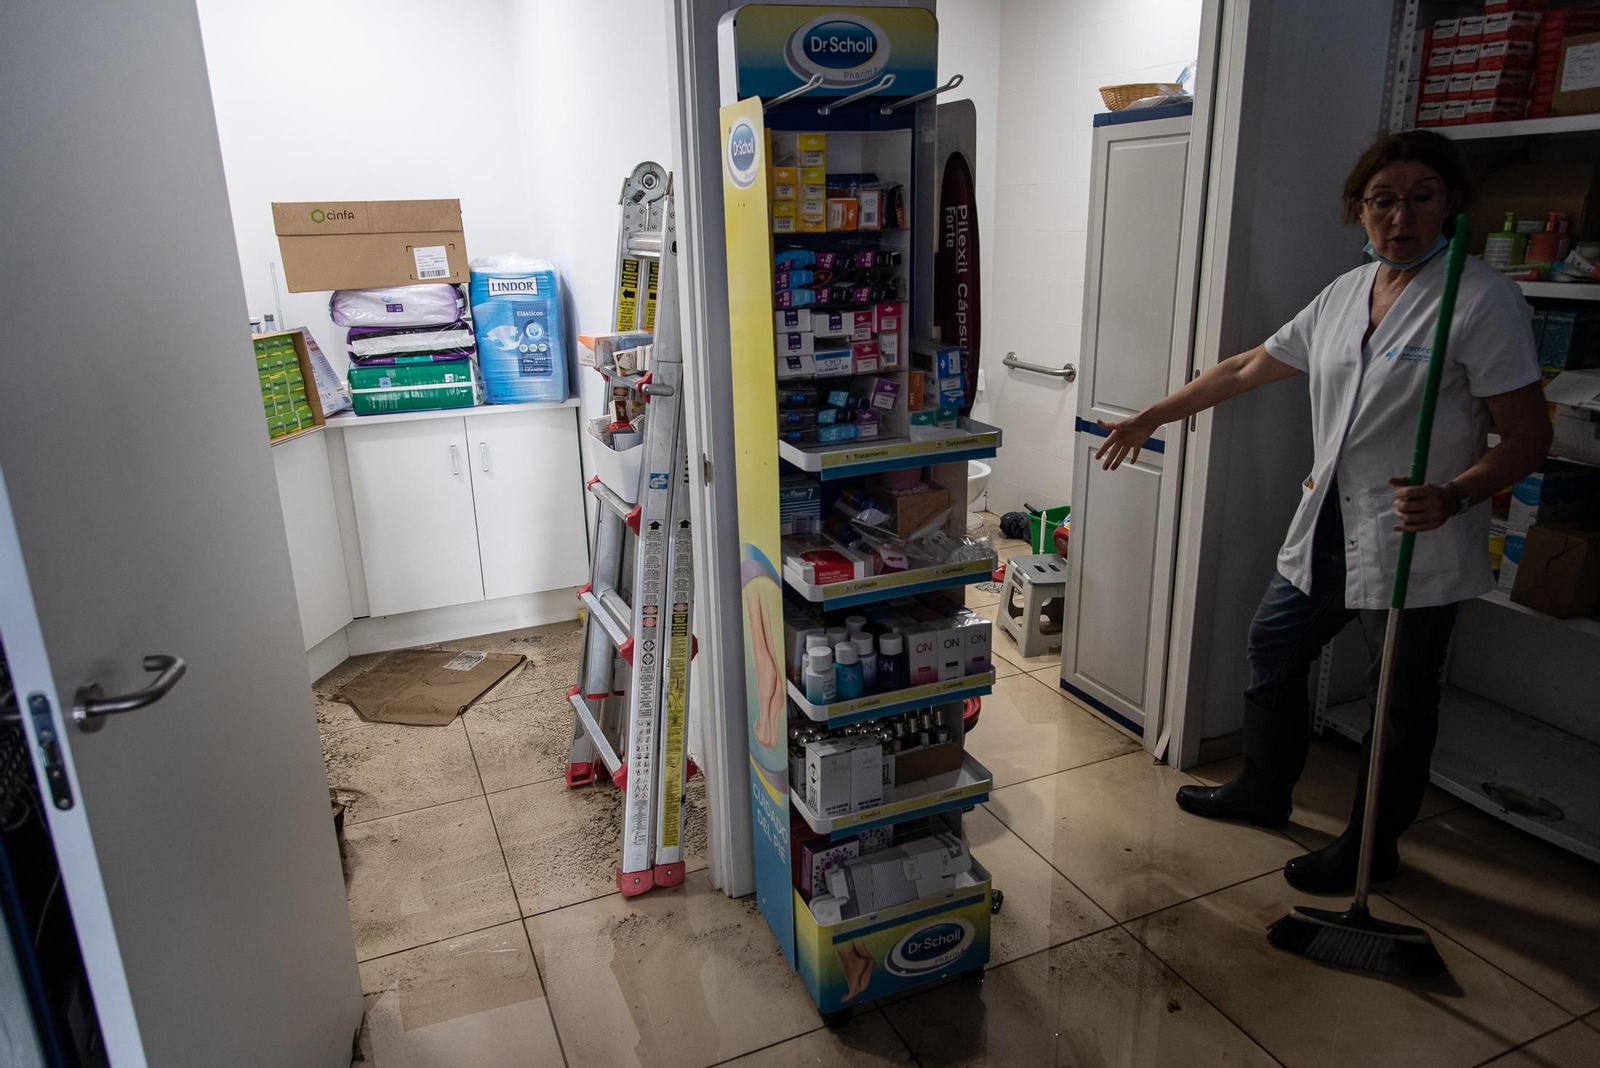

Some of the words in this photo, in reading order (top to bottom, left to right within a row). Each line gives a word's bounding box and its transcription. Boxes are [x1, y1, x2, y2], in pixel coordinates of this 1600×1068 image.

[326, 209, 356, 222] cinfa
[946, 206, 956, 248] Forte
[957, 204, 968, 273] Pilexil
[491, 281, 535, 293] LINDOR
[516, 310, 544, 318] Elásticos
[853, 449, 889, 460] Tratamiento
[854, 580, 878, 590] Cuidado
[944, 637, 960, 649] ON
[970, 633, 987, 645] ON
[916, 642, 932, 654] ON
[878, 660, 893, 672] ON
[752, 783, 788, 844] CUIDADO
[757, 808, 772, 842] DEL
[773, 833, 786, 864] PIE
